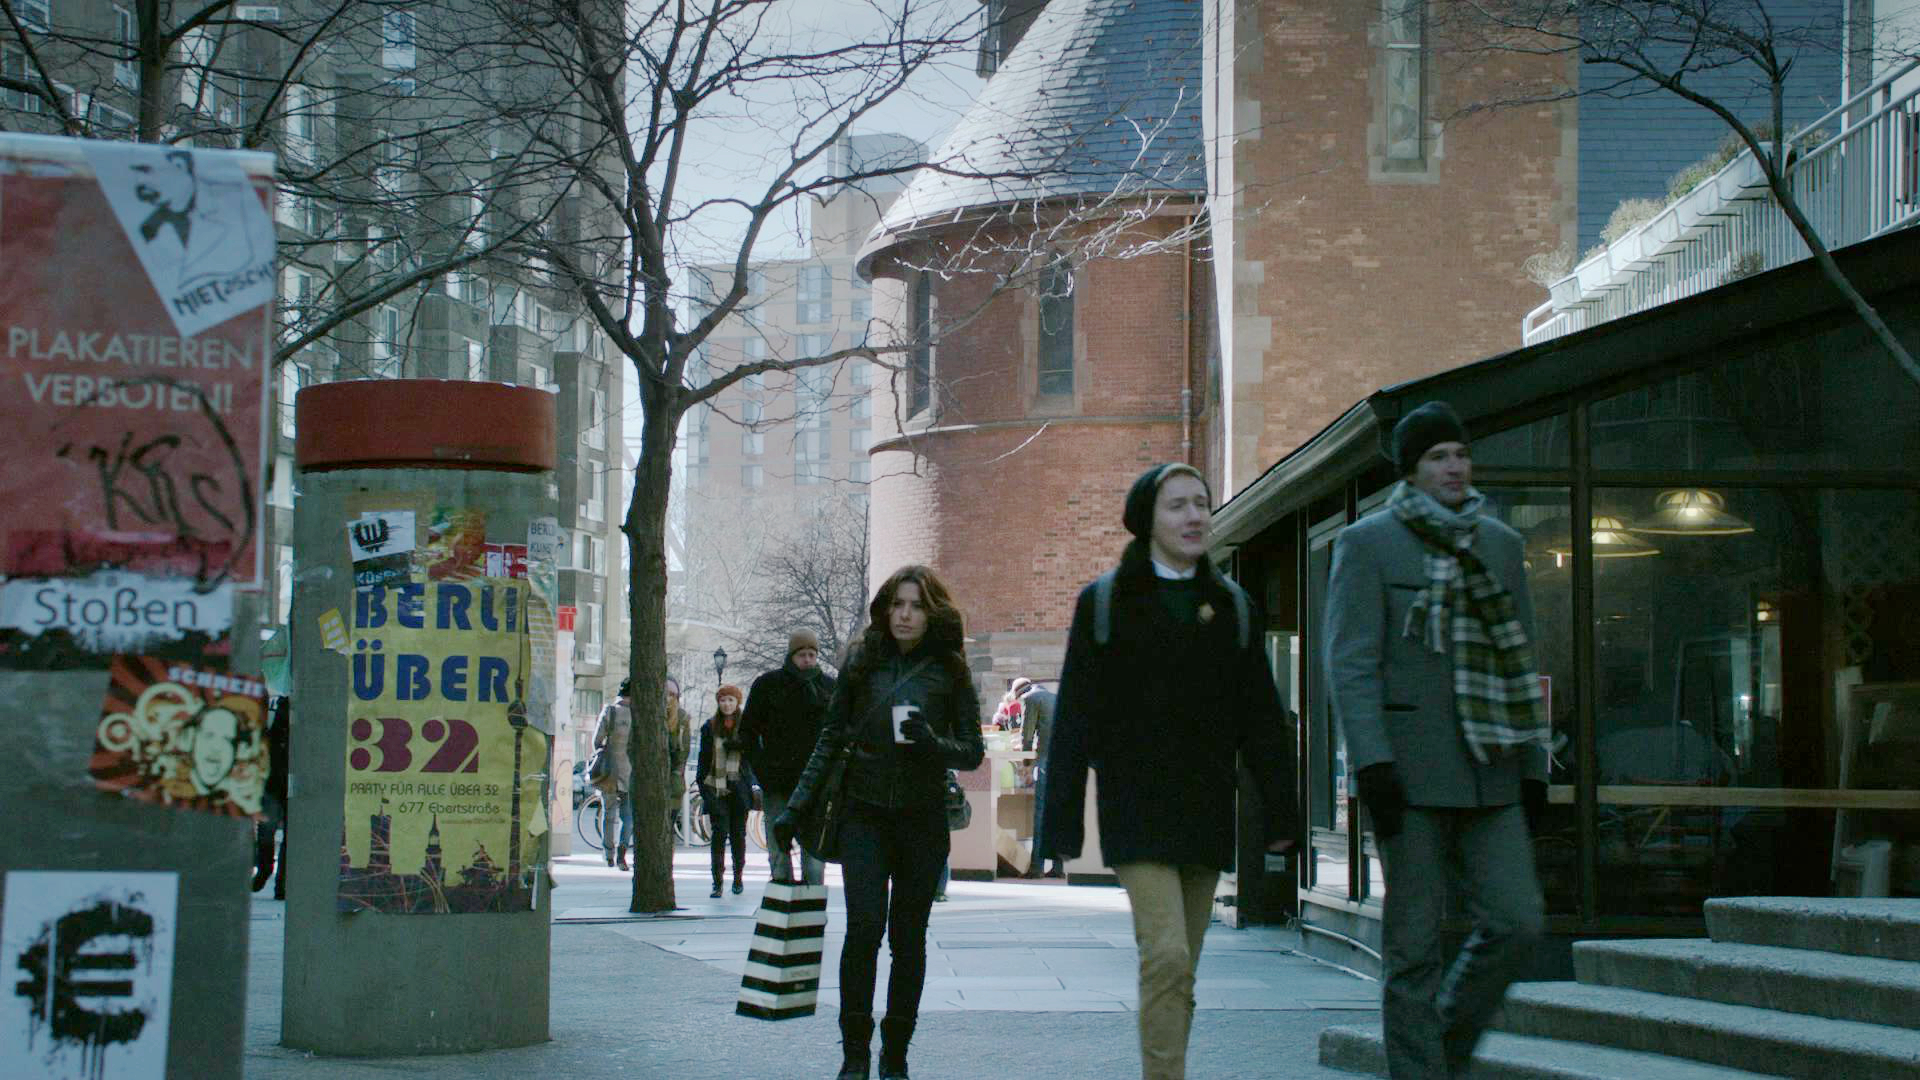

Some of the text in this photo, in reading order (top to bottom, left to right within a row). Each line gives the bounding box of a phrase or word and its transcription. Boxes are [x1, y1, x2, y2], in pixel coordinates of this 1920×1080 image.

[9, 327, 252, 369] PLAKATIEREN
[25, 372, 233, 414] VERBOTEN!
[34, 587, 197, 628] Stoßen
[353, 638, 510, 703] ÜBER
[350, 717, 480, 774] 32
[351, 781, 500, 796] PARTY FÜR ALLE ÜBER 32
[399, 801, 501, 815] 677 Ebertstraße
